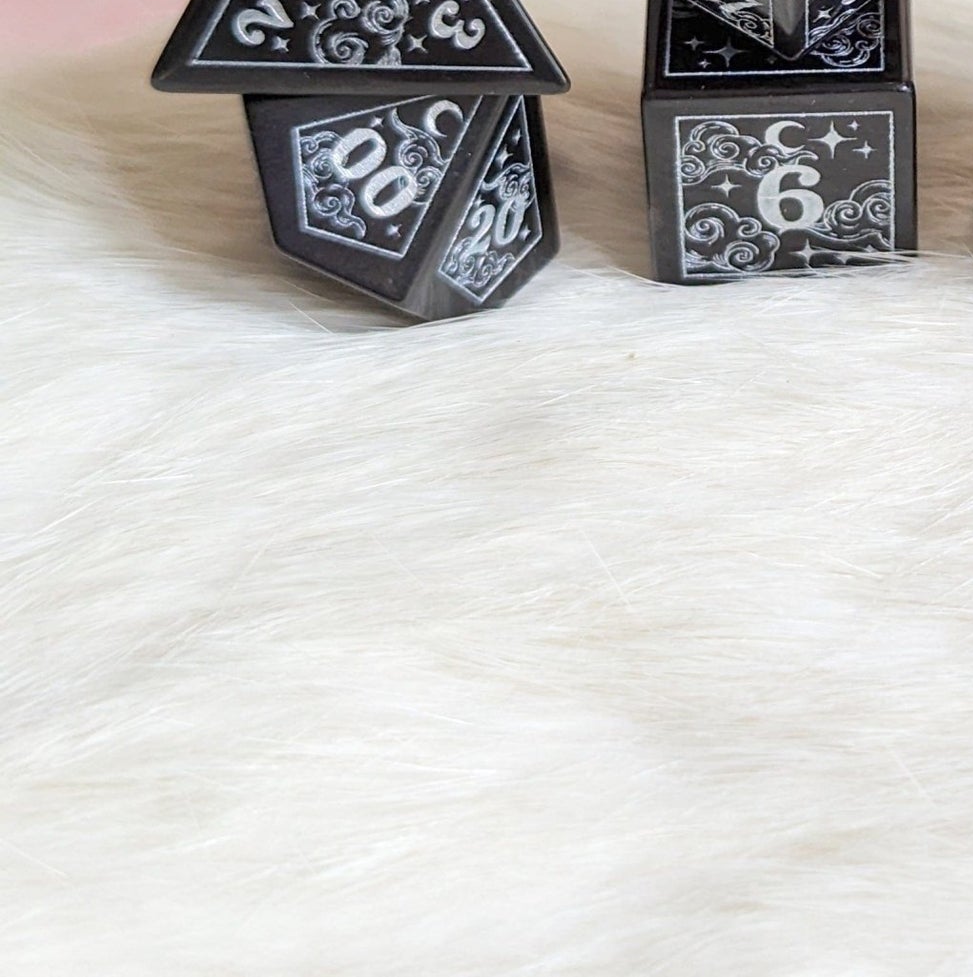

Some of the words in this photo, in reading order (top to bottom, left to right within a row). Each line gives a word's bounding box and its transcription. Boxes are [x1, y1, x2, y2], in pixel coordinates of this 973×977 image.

[428, 5, 486, 50] 3
[332, 128, 418, 218] 00
[757, 163, 825, 230] 6
[465, 198, 525, 257] 20
